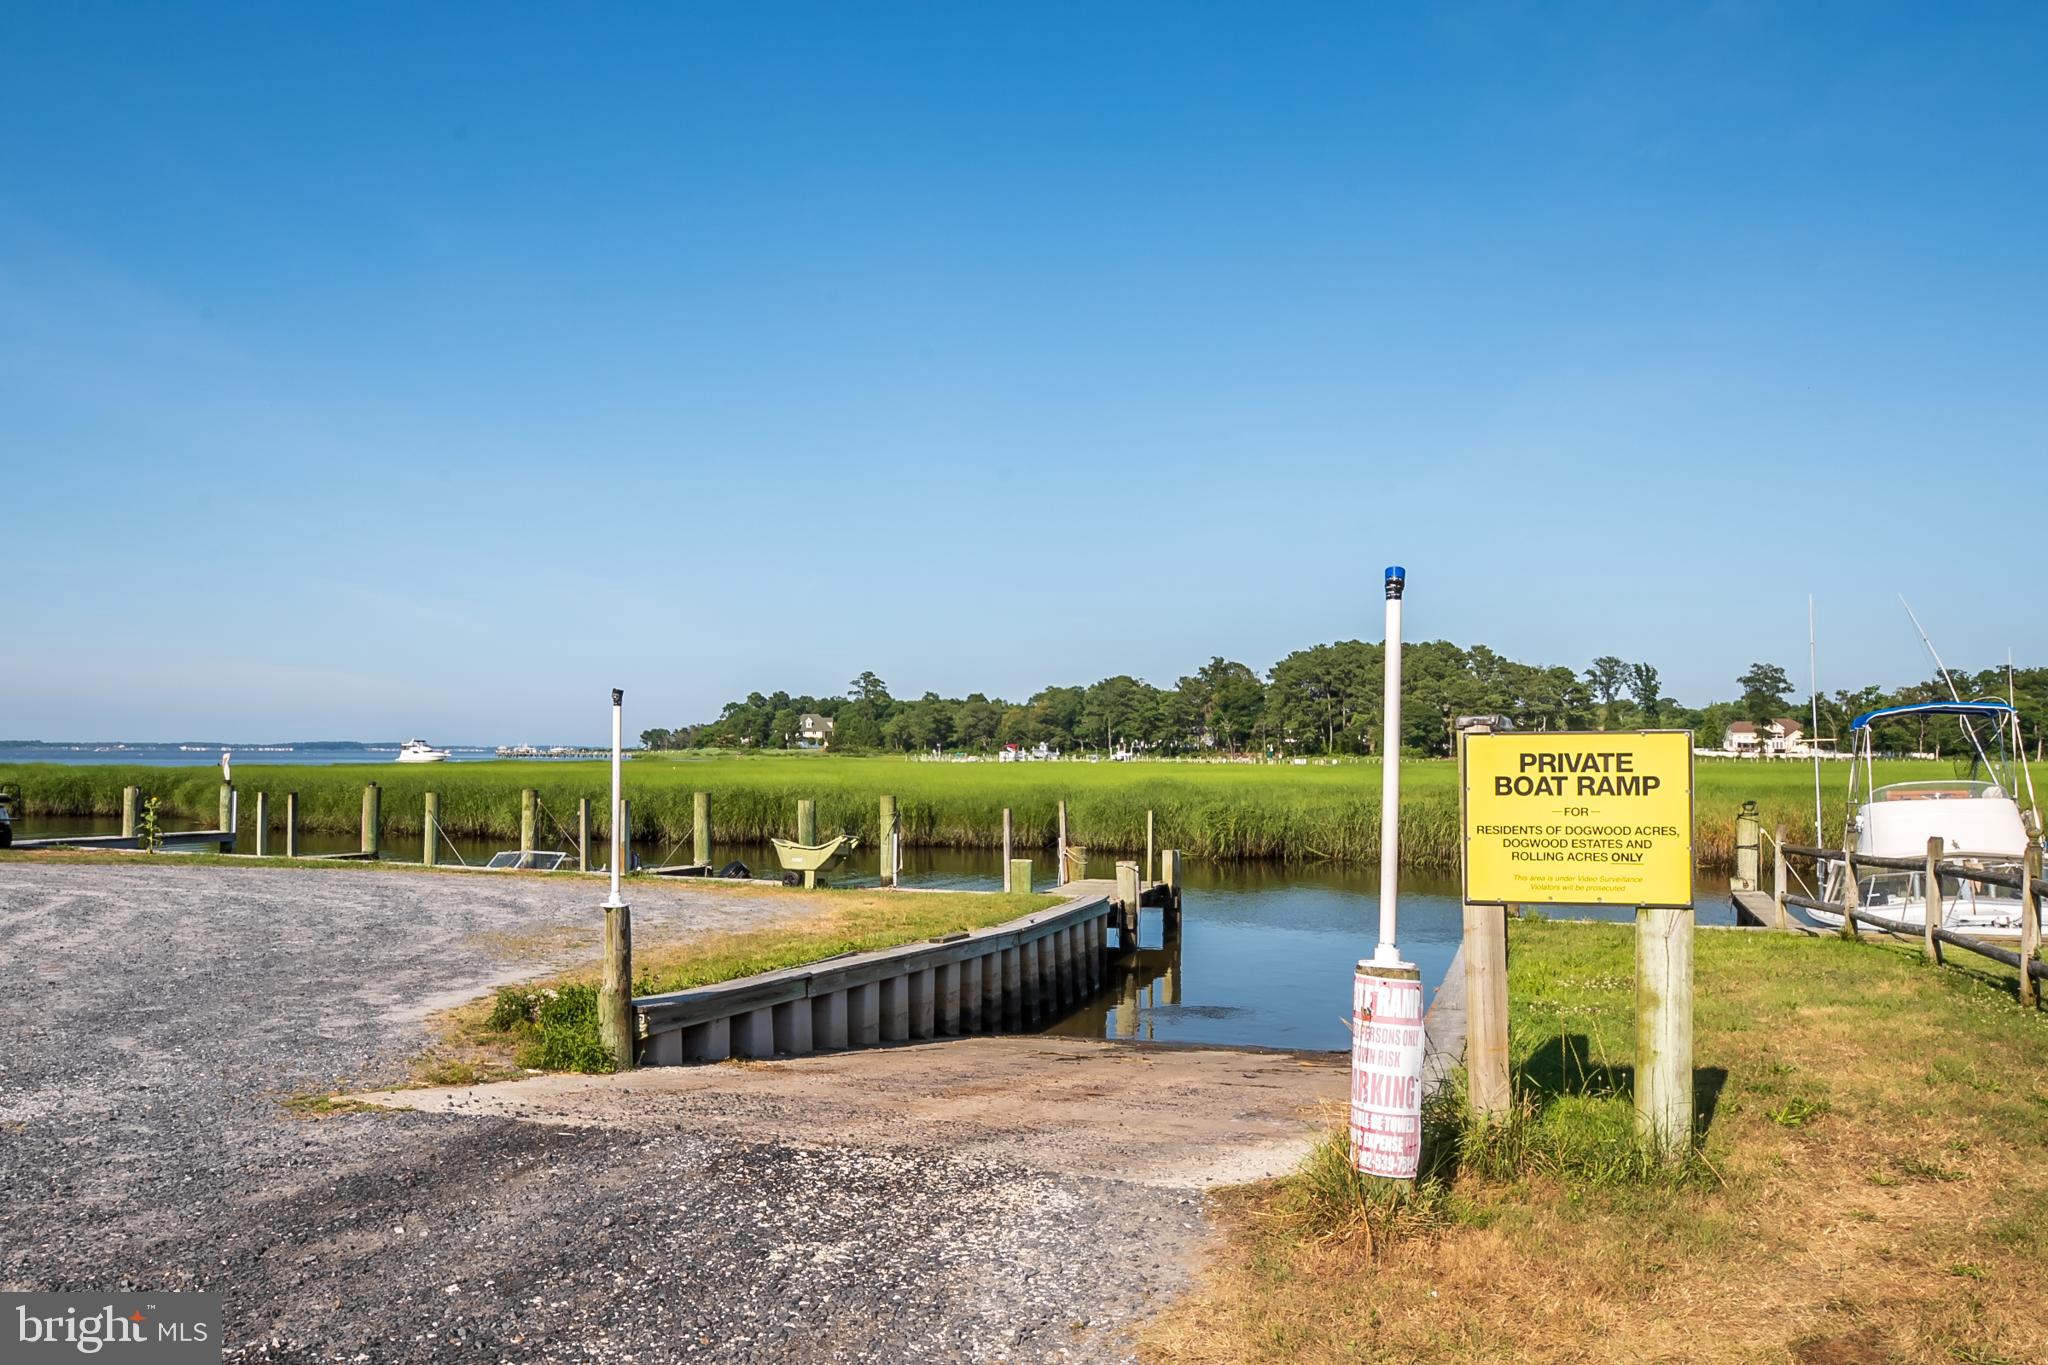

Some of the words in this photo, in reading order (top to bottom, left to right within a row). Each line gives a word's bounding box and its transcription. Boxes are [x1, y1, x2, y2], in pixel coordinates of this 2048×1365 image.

[1519, 752, 1634, 774] PRIVATE
[1494, 775, 1569, 797] BOAT
[1576, 775, 1661, 797] RAMP
[1563, 807, 1590, 817] FOR
[1476, 825, 1543, 836] RESIDENTS
[1545, 825, 1563, 836] OF
[1564, 825, 1632, 837] DOGWOOD
[1634, 826, 1680, 838] ACRES,
[1502, 838, 1568, 849] DOGWOOD
[1571, 838, 1623, 850] ESTATES
[1625, 839, 1653, 850] AND
[1511, 851, 1564, 862] ROLLING
[1566, 852, 1609, 863] ACRES
[1610, 852, 1644, 863] ONLY
[1577, 875, 1598, 883] Video
[1360, 1024, 1401, 1046] PERSONS
[1402, 1029, 1420, 1047] ONLY
[1357, 1046, 1376, 1064] OWN
[1377, 1048, 1401, 1068] RISK
[1363, 1131, 1404, 1153] EXPENSE
